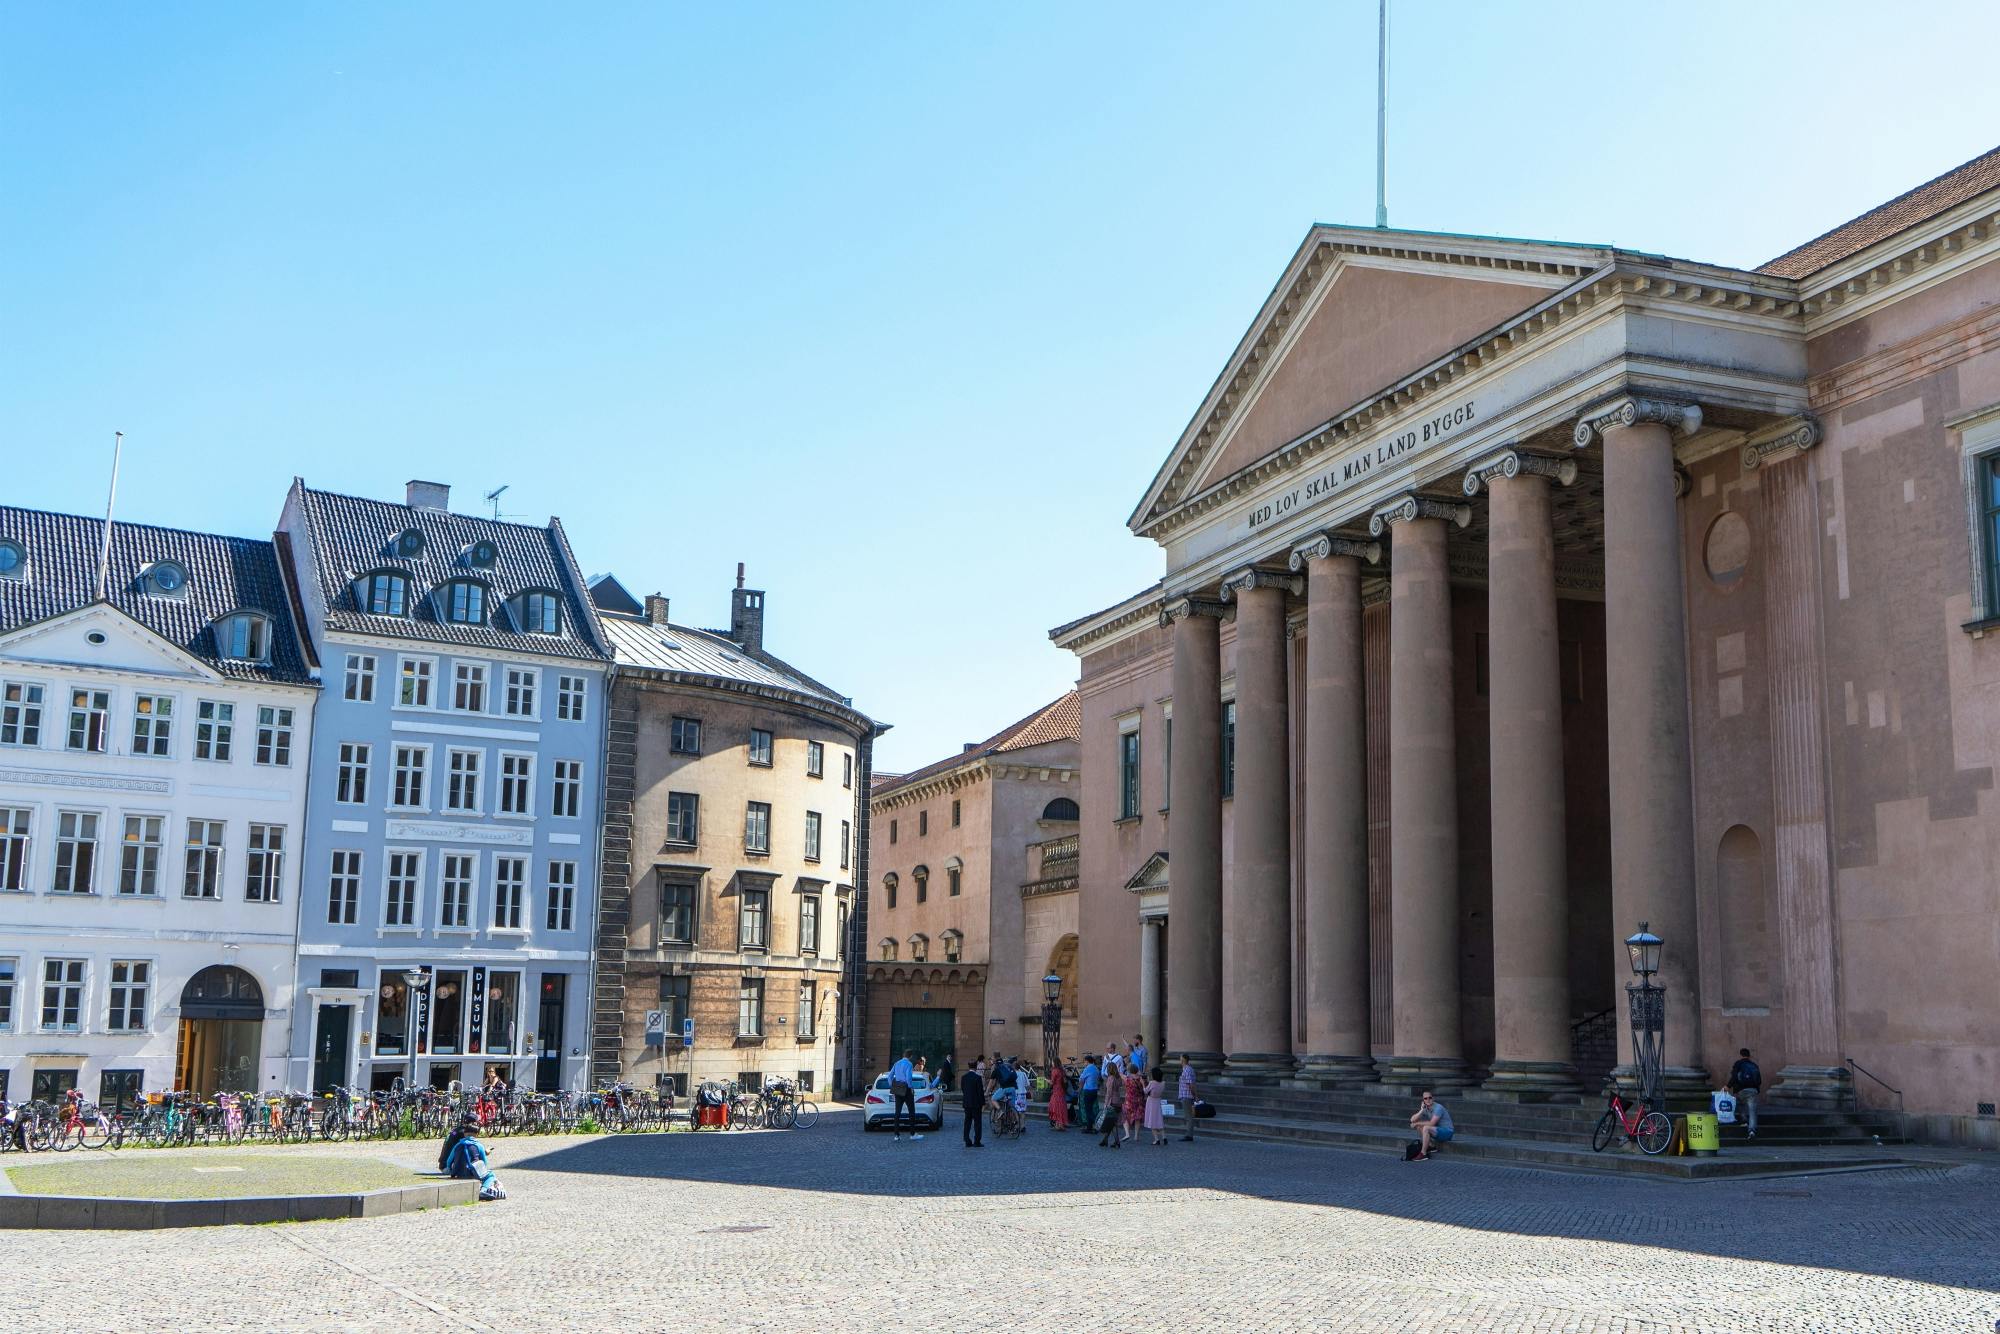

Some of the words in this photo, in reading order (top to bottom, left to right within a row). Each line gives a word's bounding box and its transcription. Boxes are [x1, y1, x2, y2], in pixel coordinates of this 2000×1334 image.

[1248, 506, 1271, 528] MED
[1276, 490, 1299, 515] LOV
[1306, 472, 1338, 499] SKAL
[1344, 453, 1371, 481] MAN
[1378, 432, 1416, 464] LAND
[1423, 401, 1475, 441] BYGGE
[418, 971, 430, 1032] IDDEN
[472, 973, 482, 1033] DIMSUM
